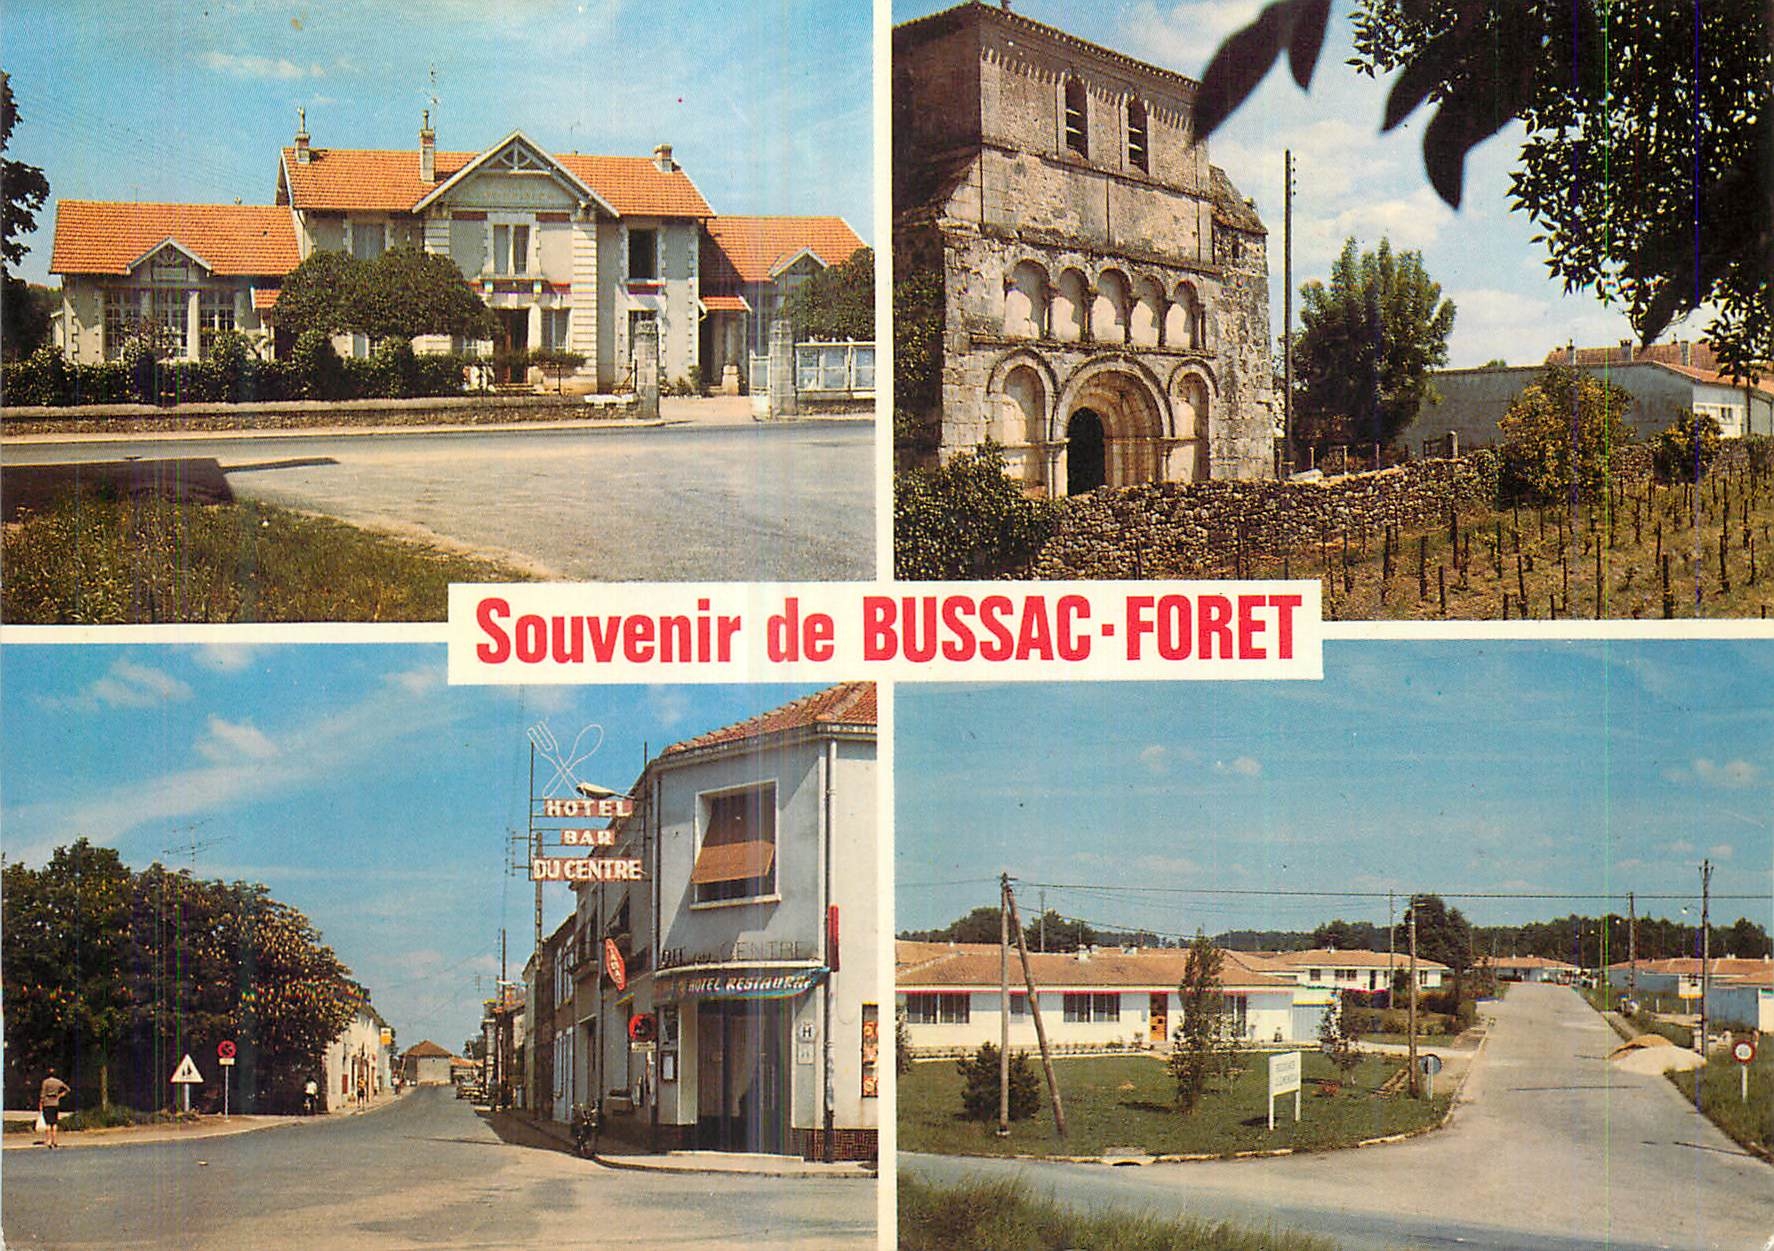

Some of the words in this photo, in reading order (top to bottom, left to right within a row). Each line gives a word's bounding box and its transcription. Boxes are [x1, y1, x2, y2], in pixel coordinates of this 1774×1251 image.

[546, 800, 632, 817] HOTEL
[564, 830, 614, 845] BAR
[533, 859, 560, 879] DU
[564, 859, 641, 879] CENTRE
[688, 977, 721, 993] HOTEL
[802, 1026, 812, 1038] H
